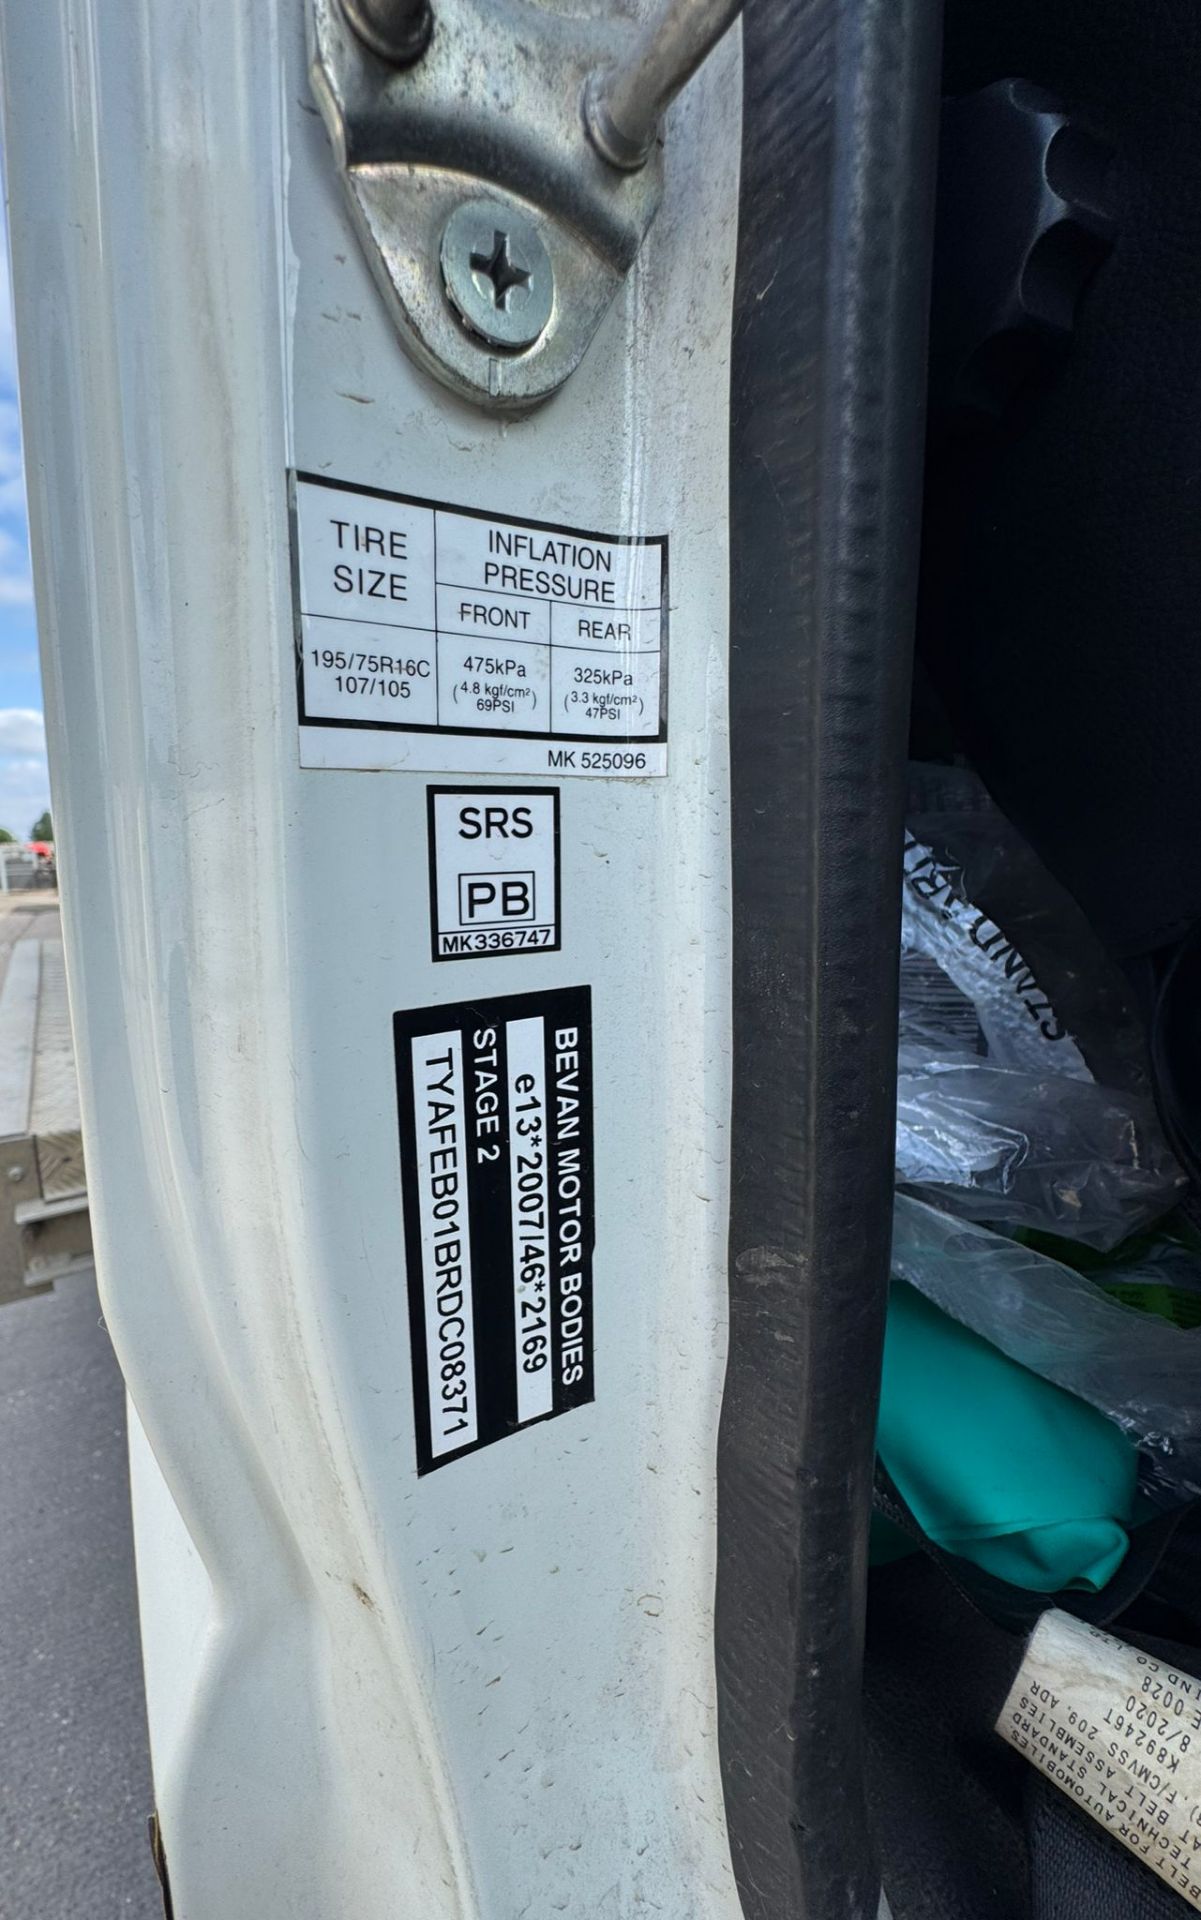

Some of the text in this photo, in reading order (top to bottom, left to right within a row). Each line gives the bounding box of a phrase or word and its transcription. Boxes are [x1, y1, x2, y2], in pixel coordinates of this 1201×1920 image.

[330, 519, 408, 560] TIRE
[488, 529, 612, 573] INFLATION
[333, 564, 408, 602] SIZE
[484, 562, 615, 604] PRESSURE
[459, 603, 531, 630] FRONT
[577, 619, 632, 641] REAR
[310, 649, 431, 678] 195/75R16C
[463, 656, 526, 678] 475kPa
[574, 667, 633, 686] 325kPa
[334, 676, 412, 699] 107/105
[476, 698, 515, 713] 69PSI
[585, 707, 621, 720] 47PSI
[547, 750, 647, 769] MK 525096
[458, 807, 534, 840] SRS
[467, 881, 530, 918] PB
[442, 928, 552, 954] MK336747
[472, 1027, 501, 1164] STAGE 2
[555, 1027, 583, 1386] BEVAN MOTOR BODIES
[424, 1046, 469, 1437] TYAFEB01BRDC08371
[1136, 1655, 1160, 1673] CO
[1029, 1680, 1060, 1709] ADR
[1141, 1676, 1184, 1717] 0028
[1019, 1696, 1116, 1779] ASSEMBLIES
[1103, 1708, 1180, 1774] K89246T
[1125, 1695, 1191, 1753] 8/2020
[1012, 1712, 1191, 1870] TECHNICAL STANDARD
[1125, 1785, 1170, 1825] BELT
[1119, 1823, 1151, 1855] FOR
[1156, 1857, 1201, 1900] BELT
